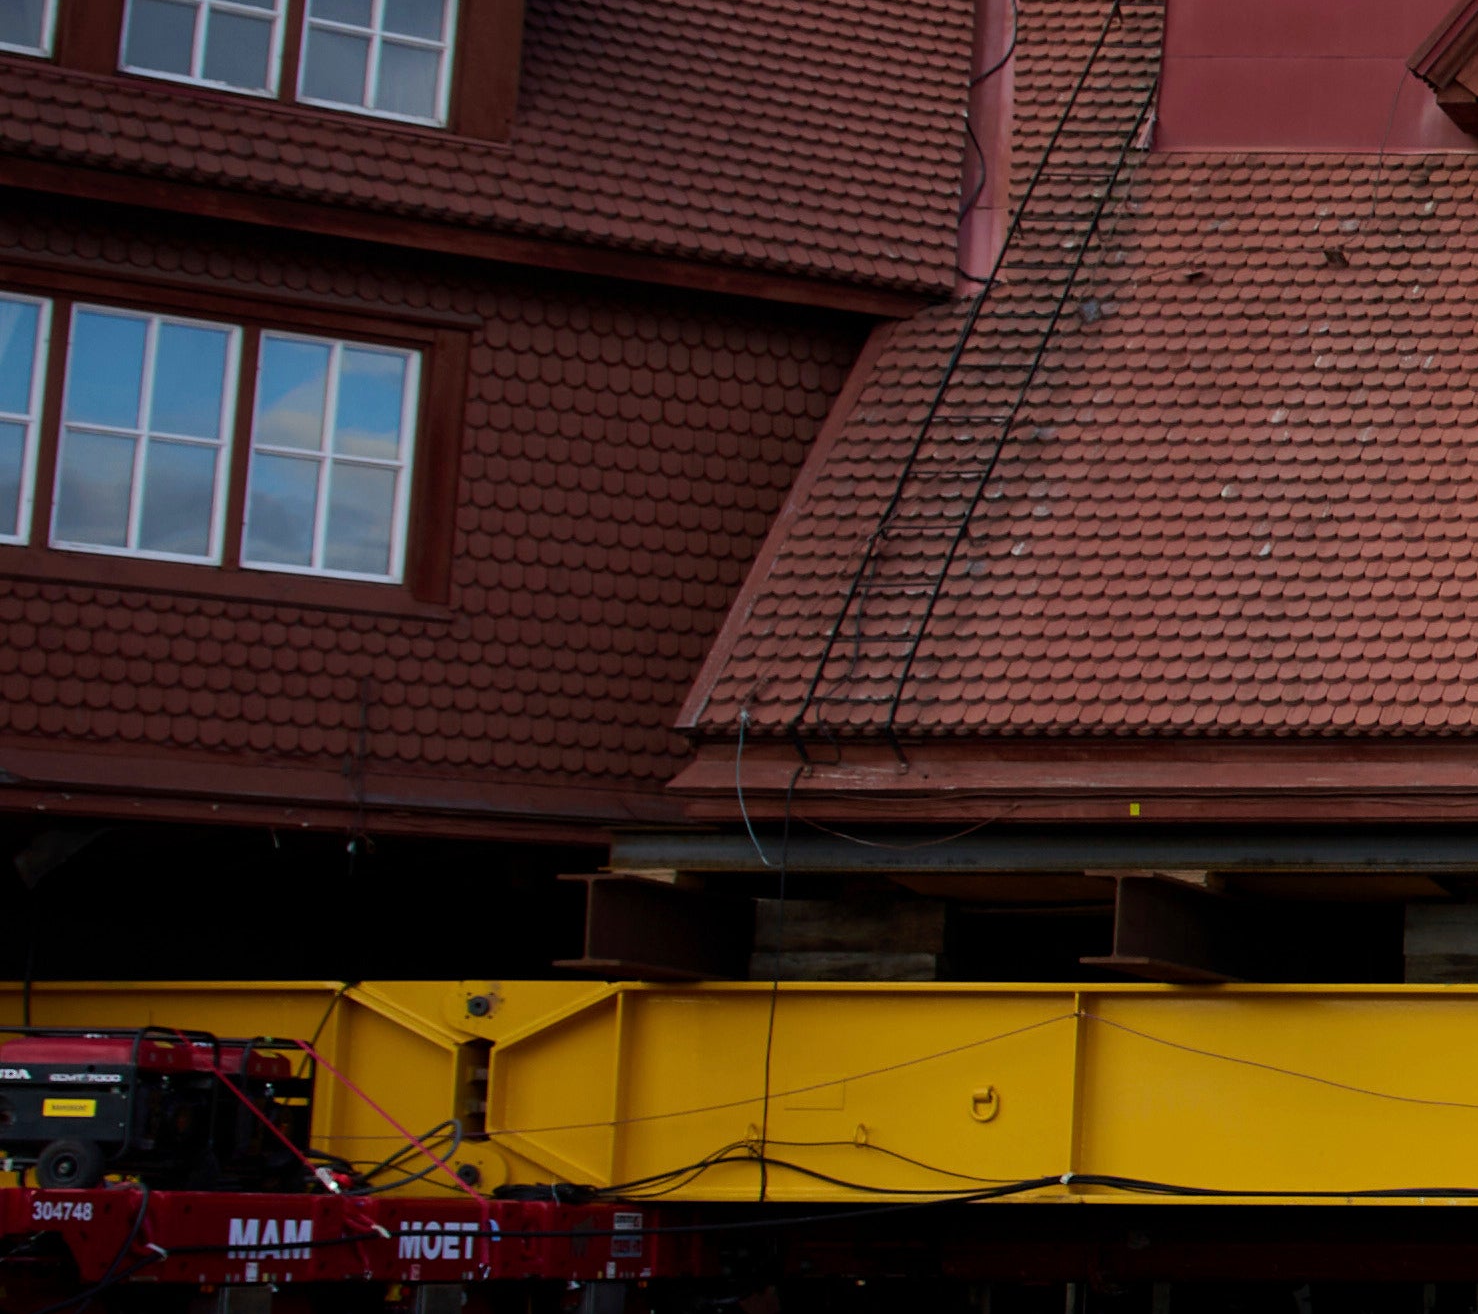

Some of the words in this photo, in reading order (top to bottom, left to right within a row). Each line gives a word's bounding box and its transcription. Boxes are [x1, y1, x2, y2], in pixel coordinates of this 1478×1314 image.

[32, 1200, 94, 1222] 304748
[228, 1218, 313, 1260] MAM
[398, 1221, 480, 1260] MOET
